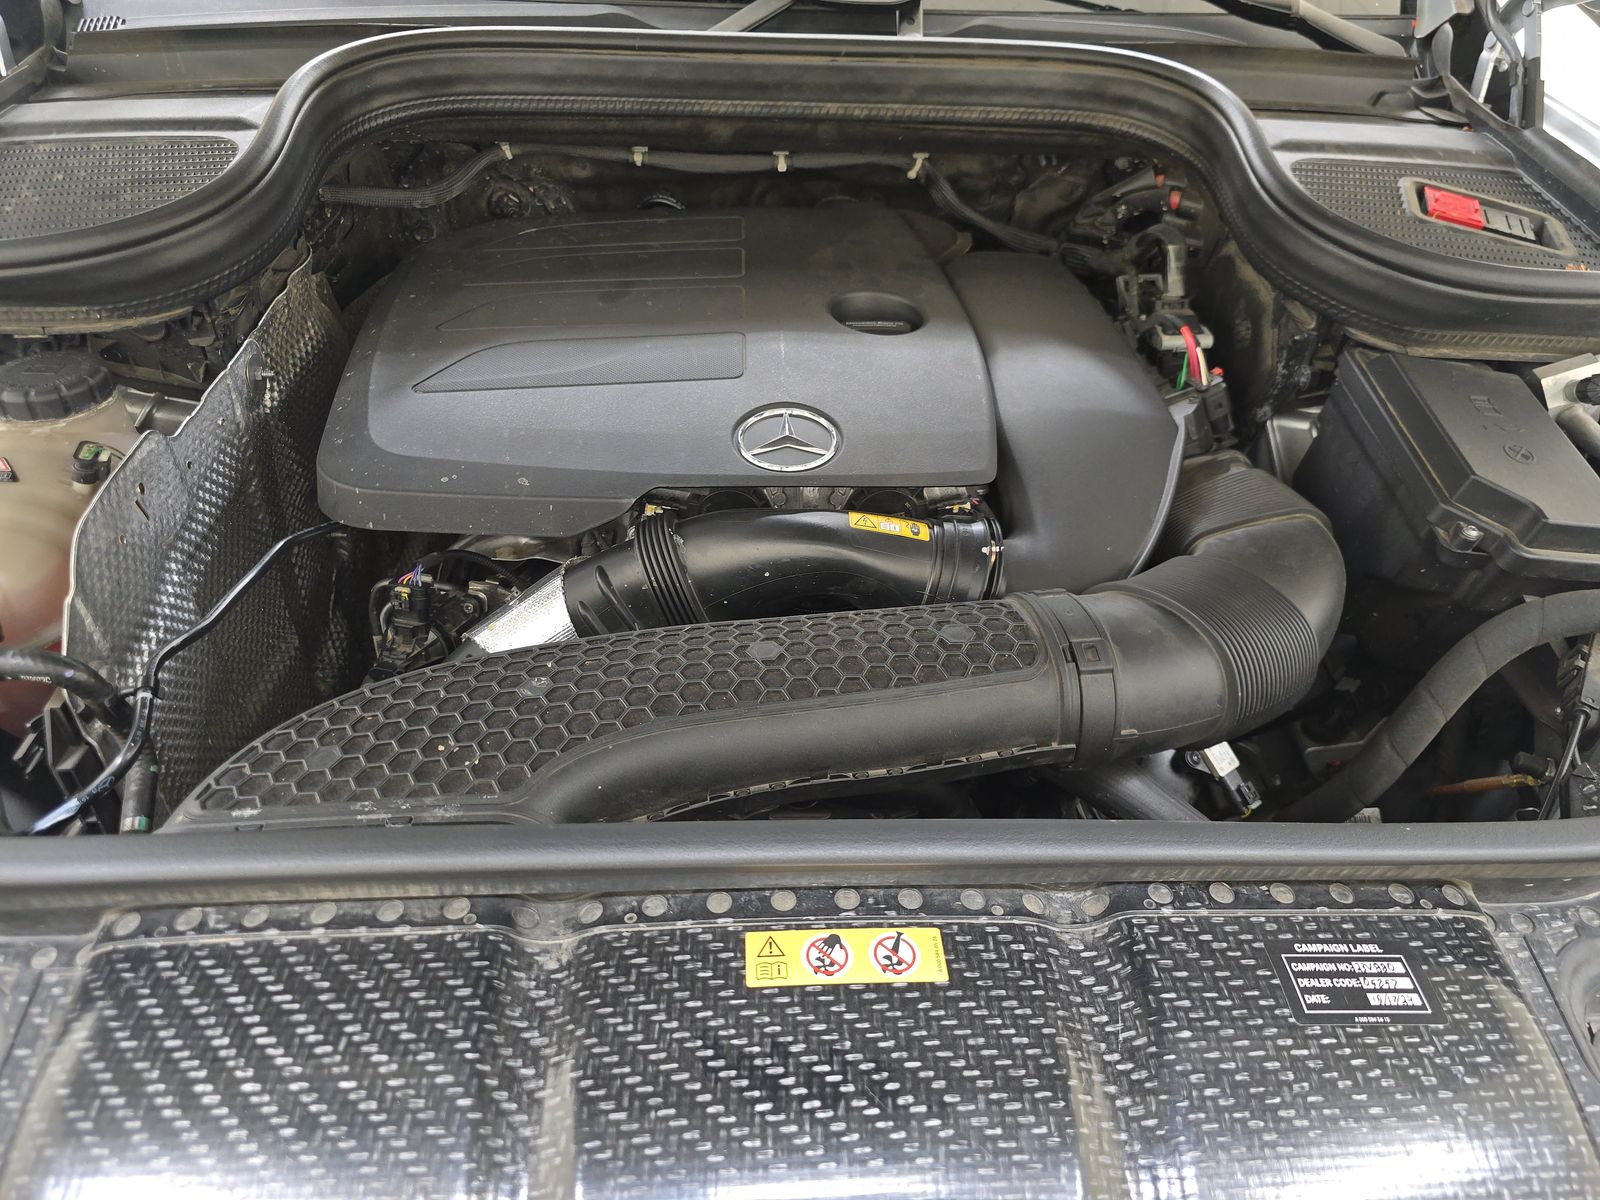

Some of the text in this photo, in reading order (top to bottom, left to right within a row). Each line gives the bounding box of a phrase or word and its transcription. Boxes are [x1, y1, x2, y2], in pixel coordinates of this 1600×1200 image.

[1294, 943, 1384, 953] CAMPAIGN LABEL
[1291, 962, 1354, 972] CAMPAIGN NO:
[1297, 978, 1362, 988] DEALER CODE:
[1303, 994, 1331, 1004] DATE:
